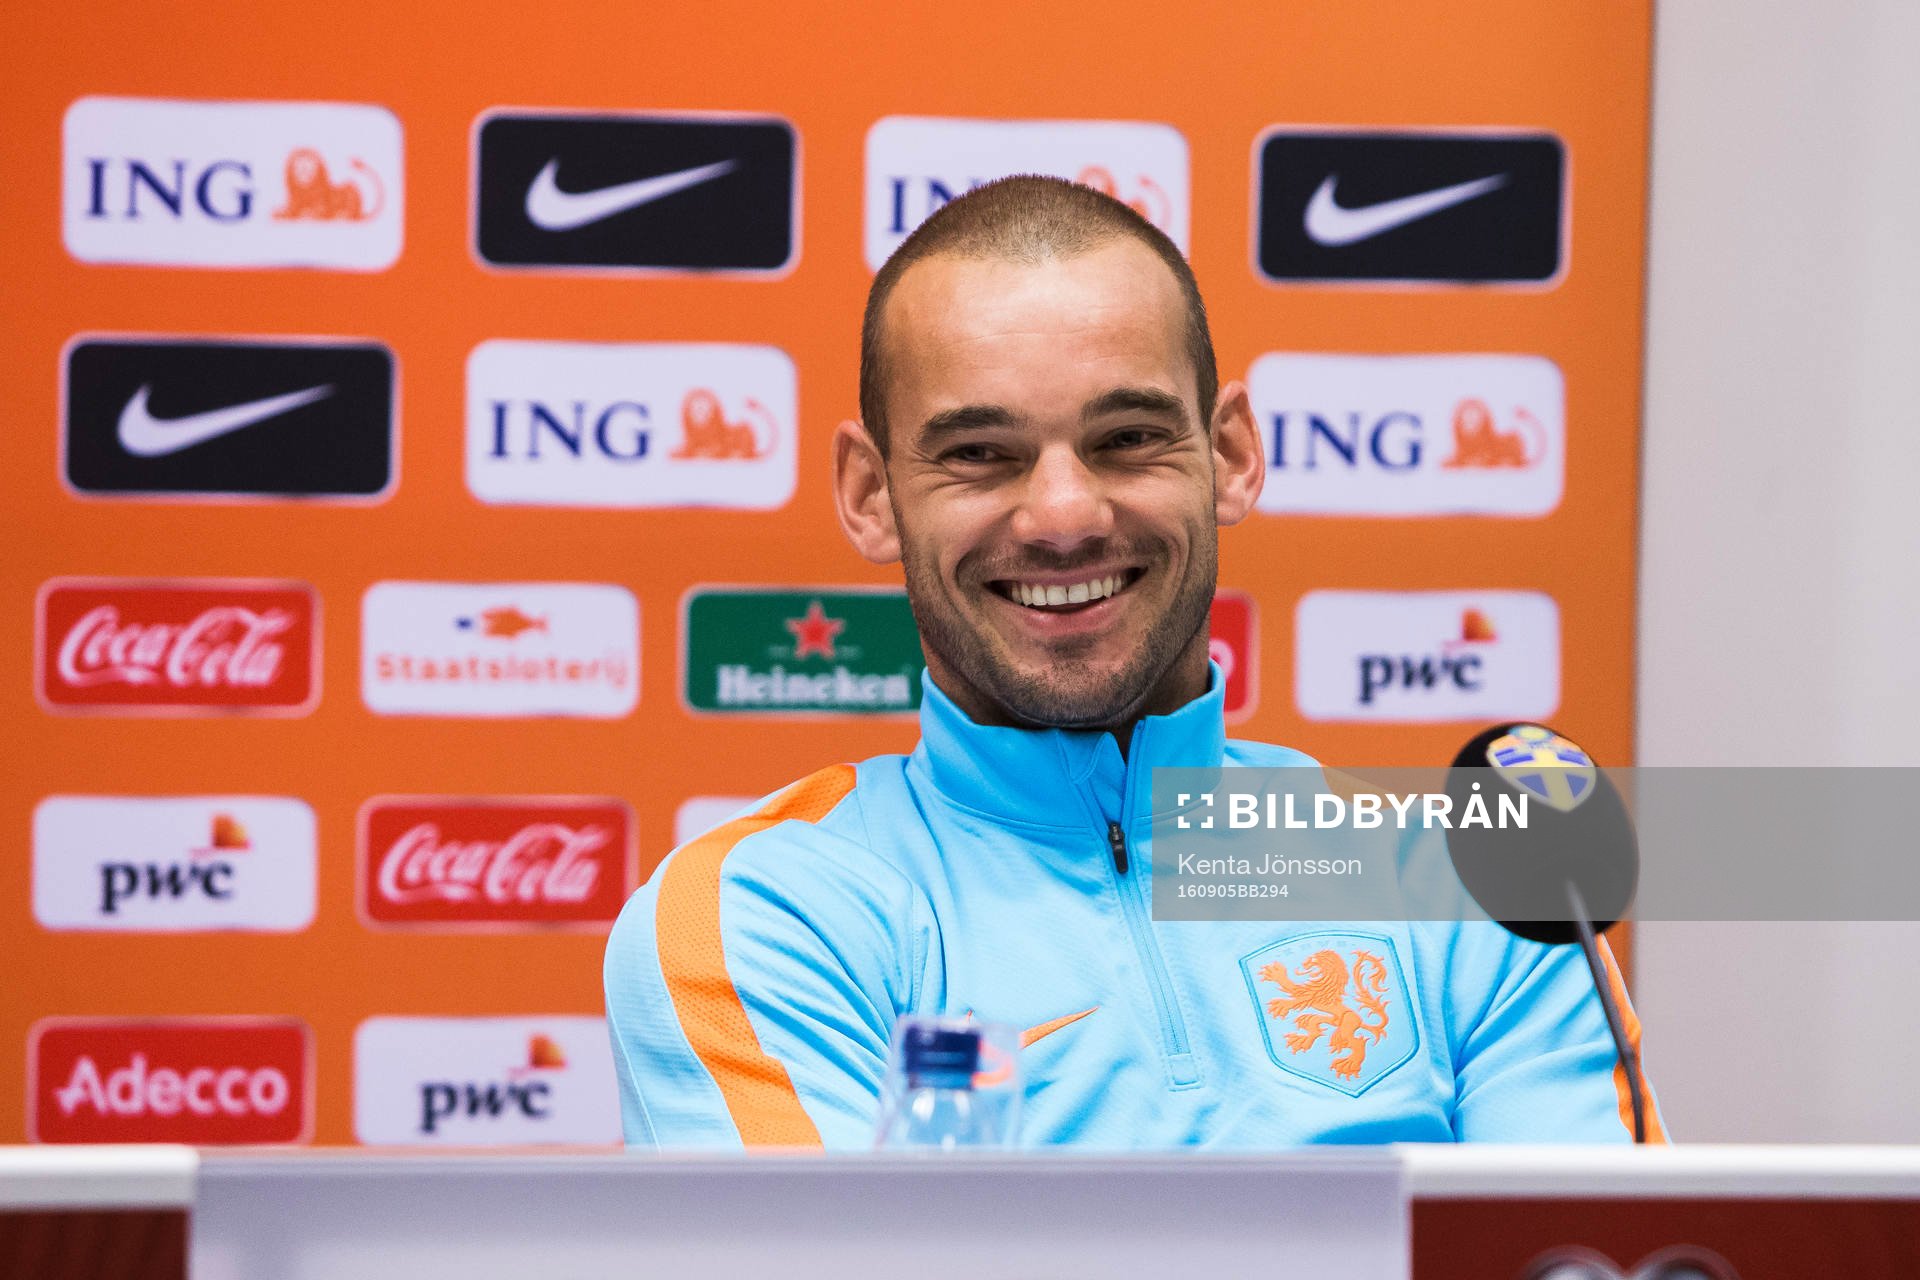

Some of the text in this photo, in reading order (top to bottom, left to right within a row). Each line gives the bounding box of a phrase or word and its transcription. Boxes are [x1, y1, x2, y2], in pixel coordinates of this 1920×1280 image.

[86, 158, 254, 222] ING
[489, 402, 652, 461] ING
[1269, 413, 1425, 472] ING
[376, 652, 629, 691] Staatsloterij
[716, 664, 911, 705] Heineken
[1357, 653, 1484, 706] pwc
[98, 861, 235, 916] pwc
[55, 1052, 290, 1117] Adecco
[418, 1080, 553, 1136] pwc
